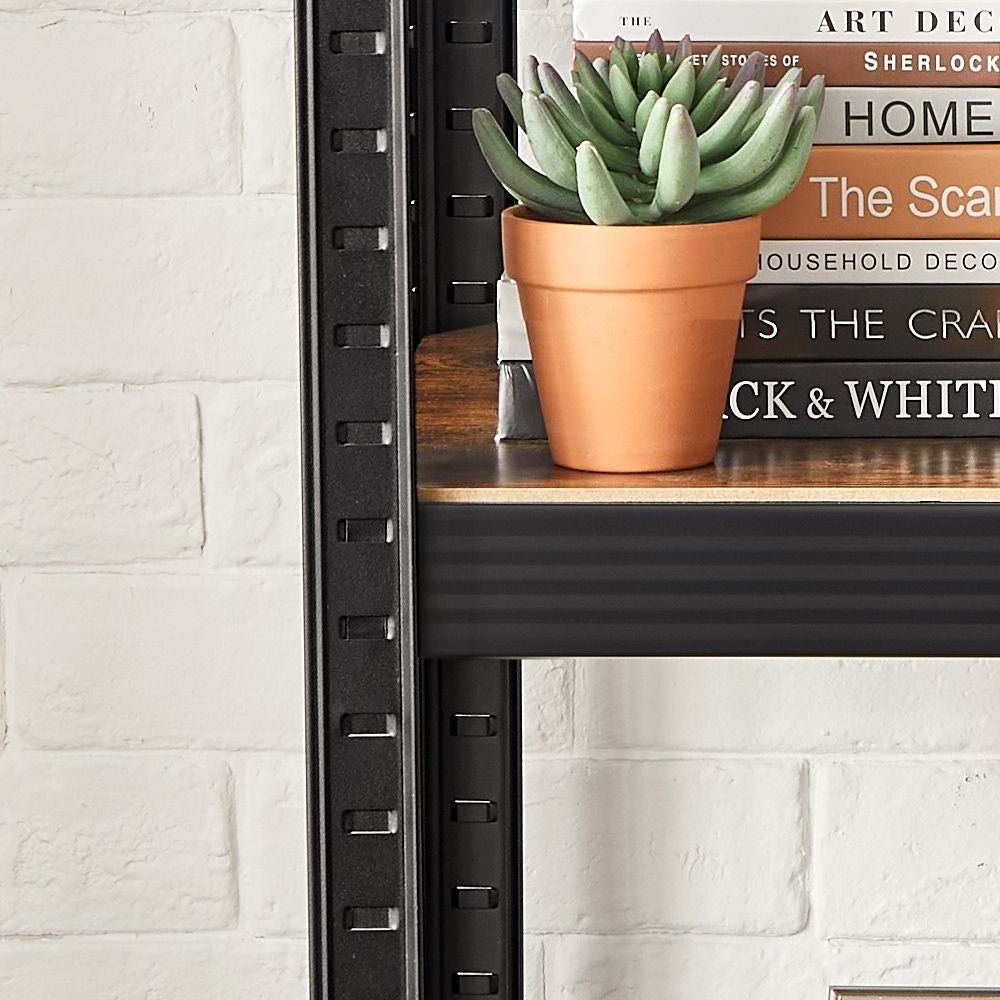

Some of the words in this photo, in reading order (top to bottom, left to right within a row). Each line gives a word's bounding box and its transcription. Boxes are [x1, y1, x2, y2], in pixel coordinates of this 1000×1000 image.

[620, 16, 652, 26] THE
[816, 9, 894, 34] ART
[782, 55, 800, 67] OF
[864, 51, 1000, 73] SHERLOCK
[844, 100, 994, 136] HOME
[809, 176, 893, 218] The
[758, 253, 911, 271] OUSEHOLD
[799, 308, 884, 339] THE
[722, 380, 797, 420] CK
[806, 387, 835, 419] &
